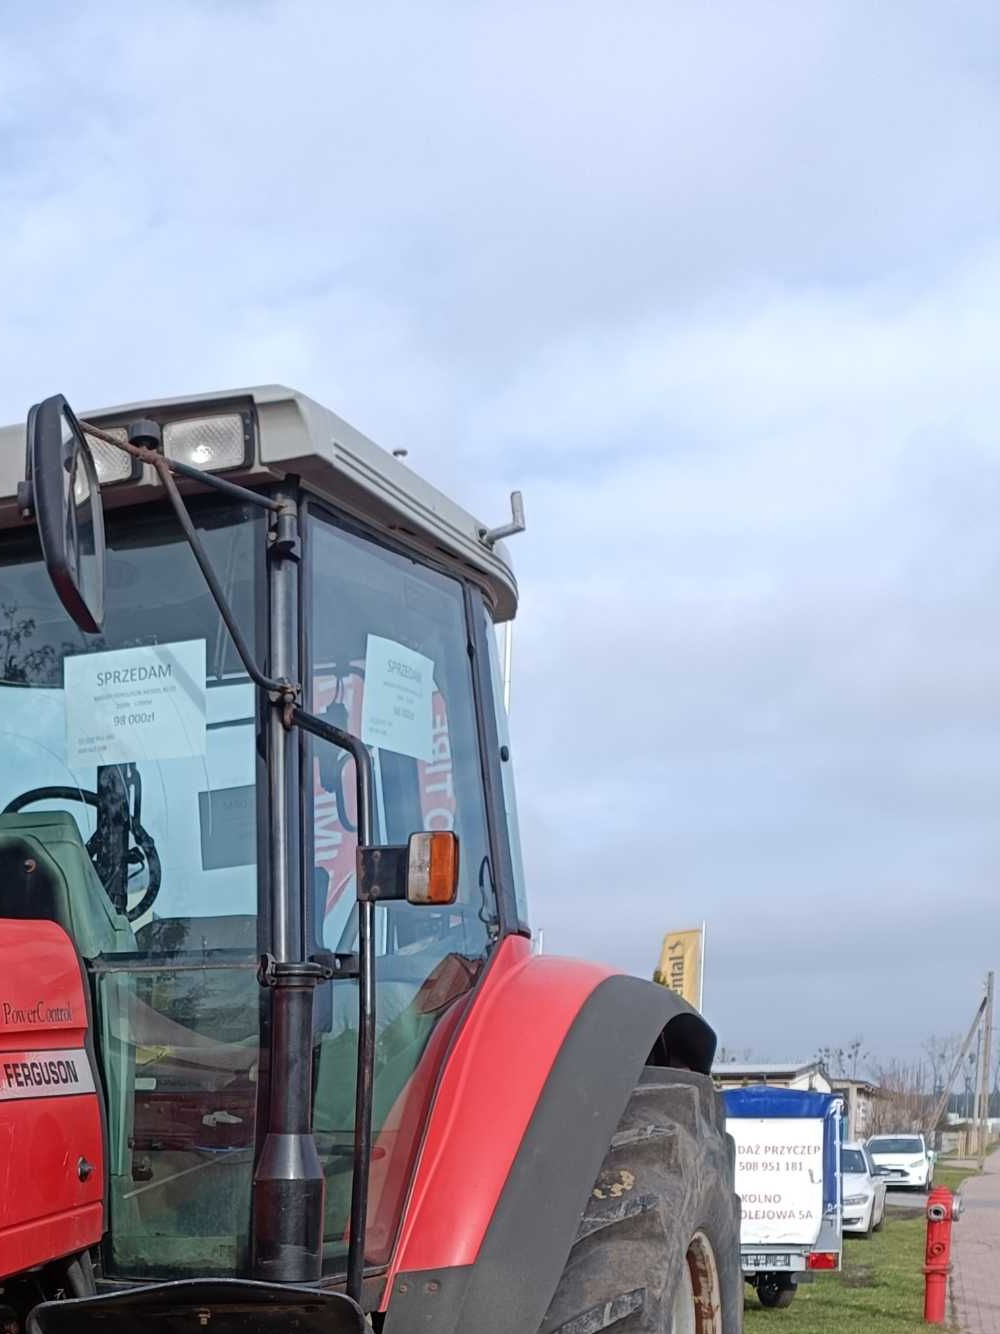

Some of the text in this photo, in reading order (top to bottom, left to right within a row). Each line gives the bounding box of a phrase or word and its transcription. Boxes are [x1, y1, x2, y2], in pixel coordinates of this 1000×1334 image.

[96, 664, 173, 687] SPRZEDAM
[668, 955, 684, 994] ntal
[3, 1001, 72, 1025] PowerControl
[3, 1060, 79, 1088] FERGUSON
[764, 1144, 821, 1156] PRZYCZEP
[739, 1161, 803, 1172] 508 951 181
